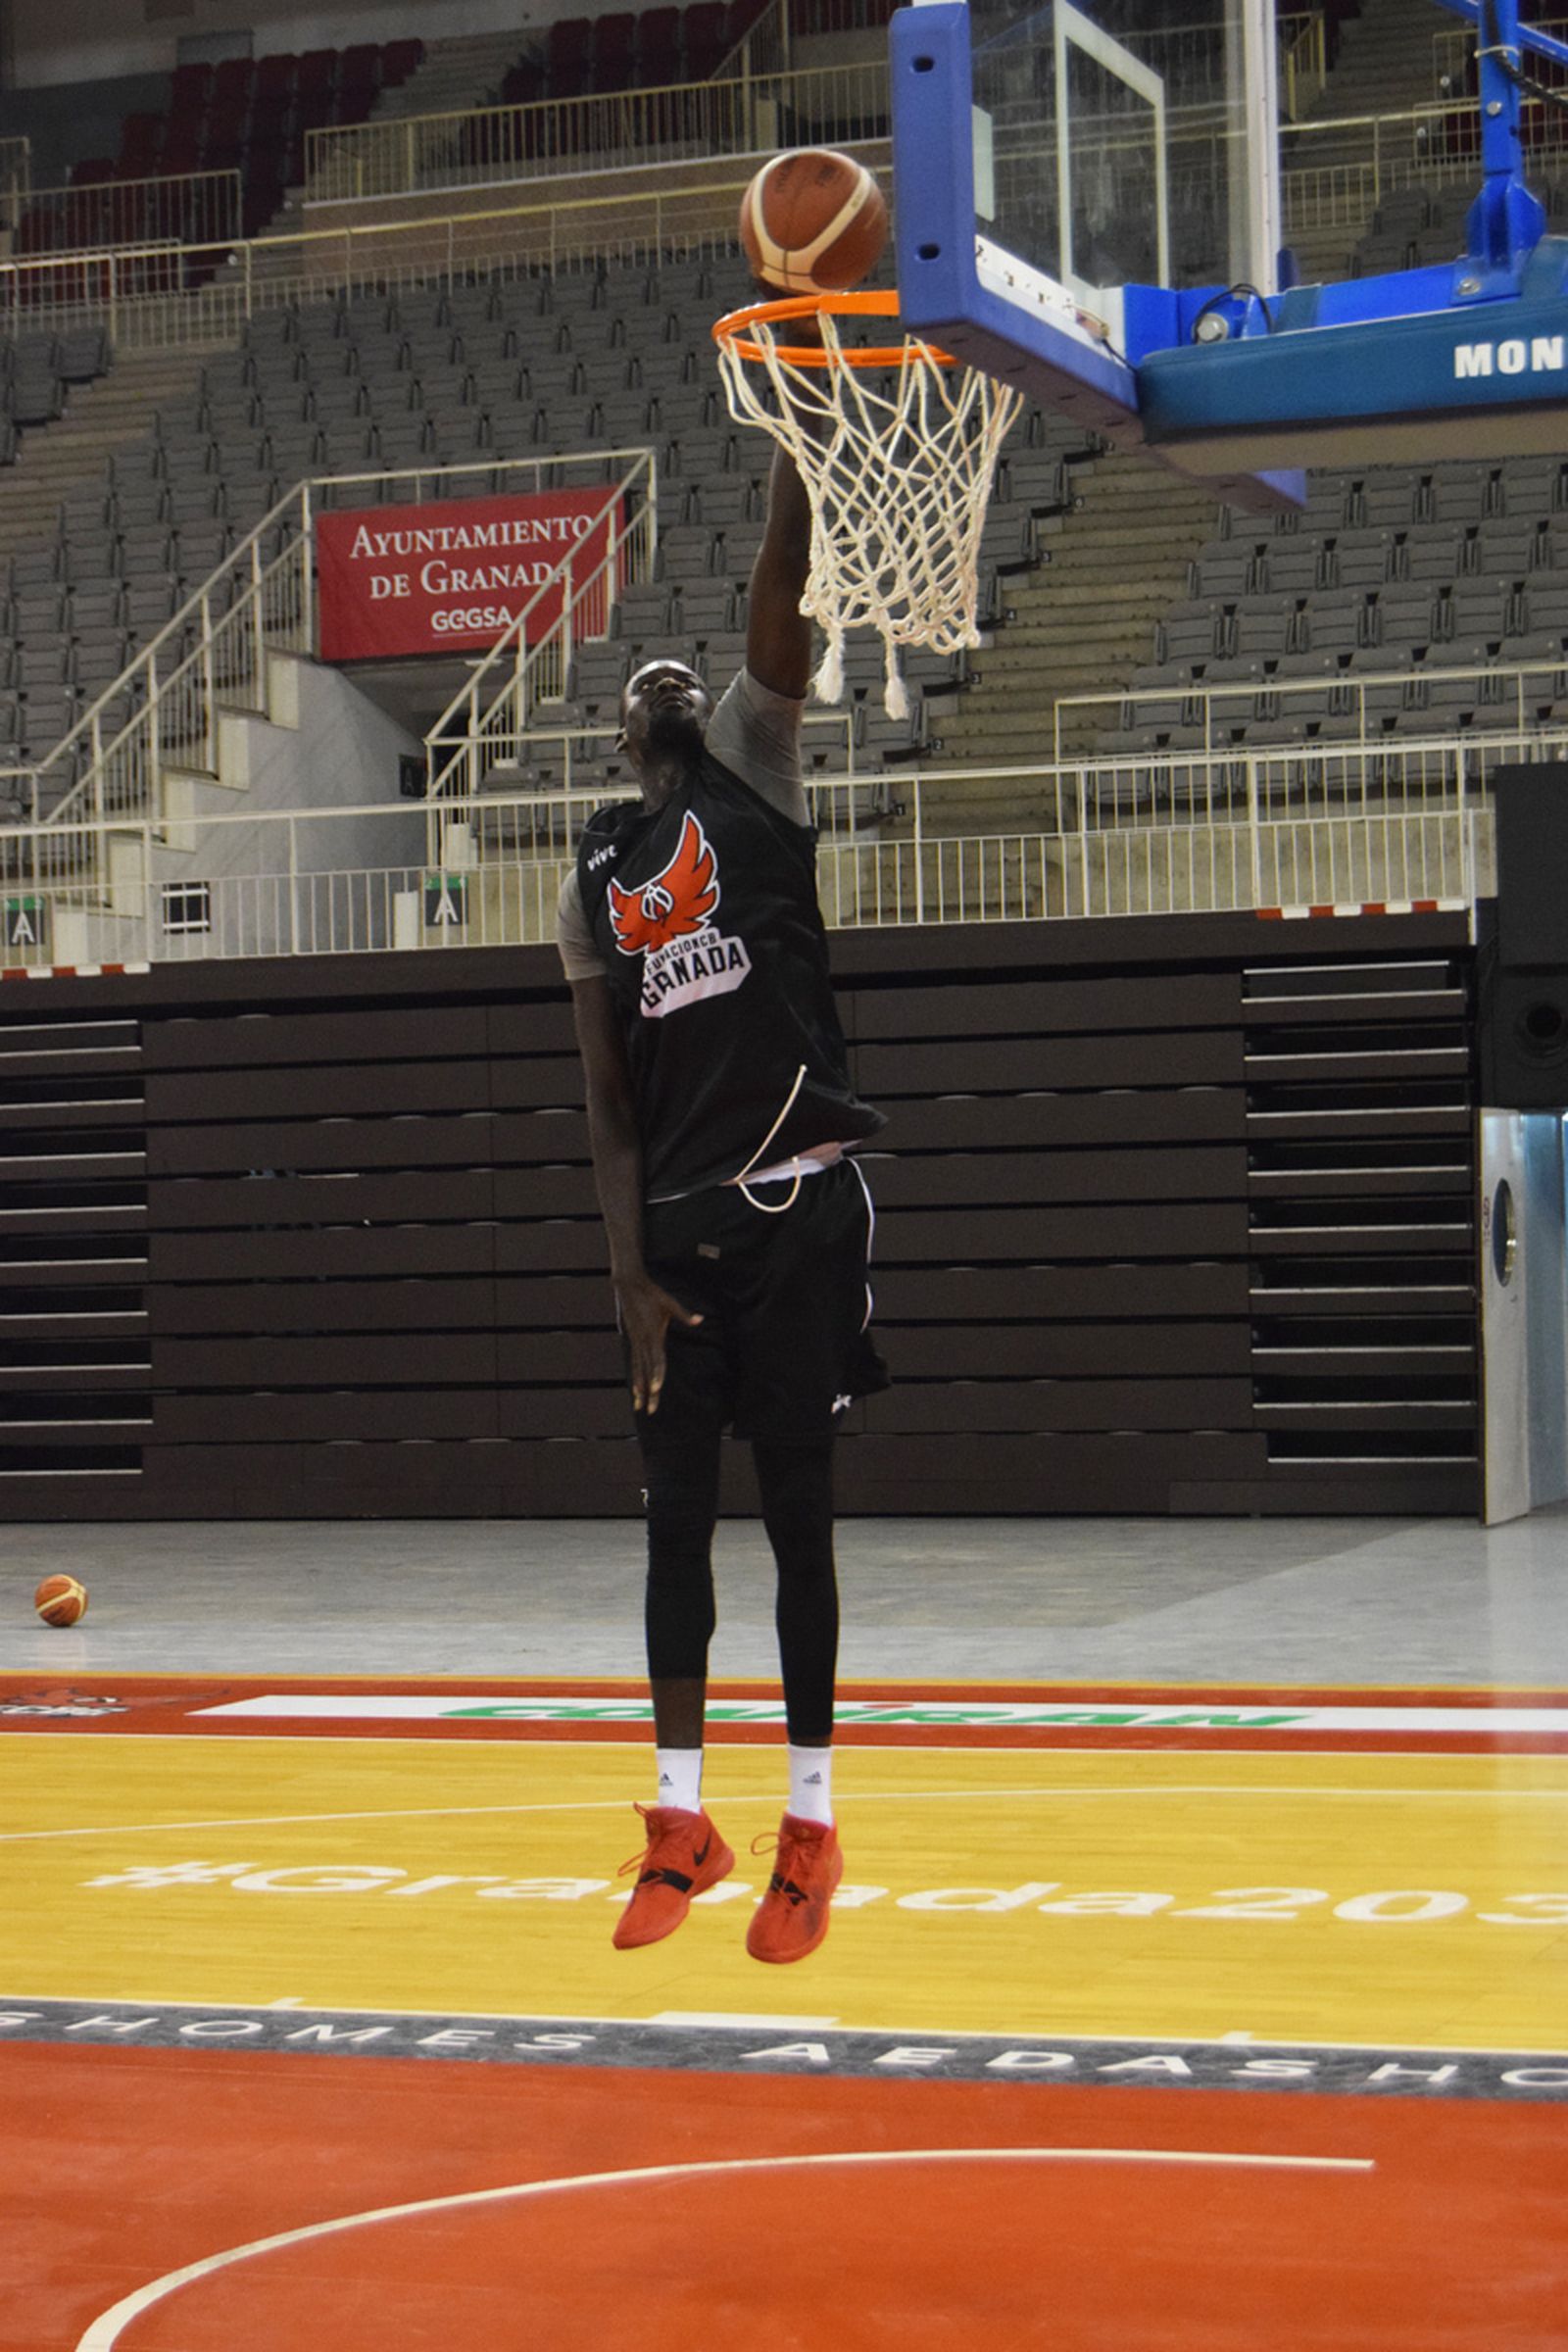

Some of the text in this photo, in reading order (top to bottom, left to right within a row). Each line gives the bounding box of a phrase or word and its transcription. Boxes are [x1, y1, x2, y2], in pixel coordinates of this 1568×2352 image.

[1454, 336, 1564, 378] MON
[349, 514, 594, 559] AYUNTAMIENTO
[369, 574, 411, 599] DE
[433, 892, 459, 923] A
[12, 911, 35, 944] A
